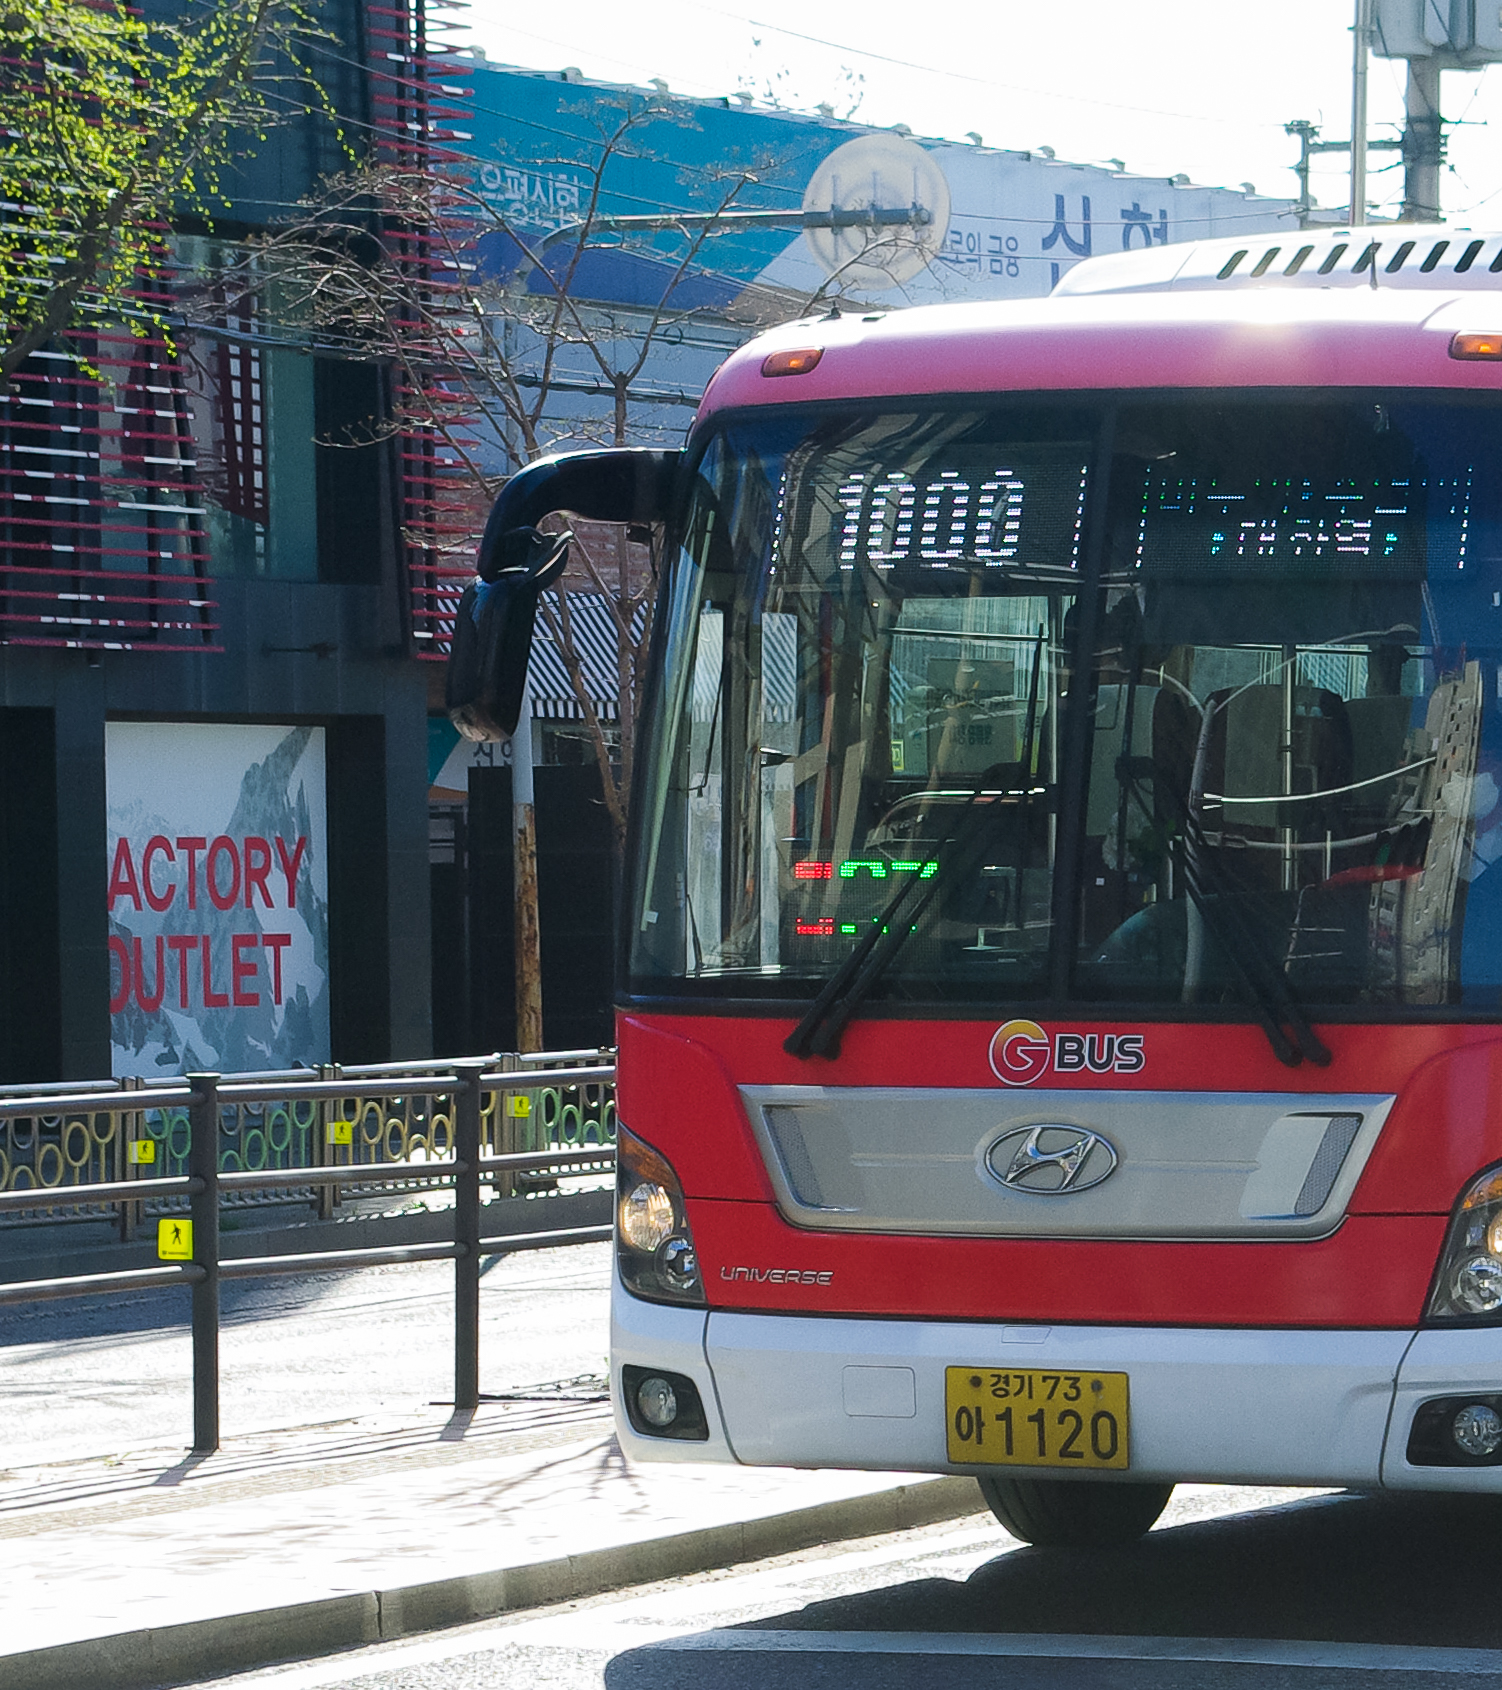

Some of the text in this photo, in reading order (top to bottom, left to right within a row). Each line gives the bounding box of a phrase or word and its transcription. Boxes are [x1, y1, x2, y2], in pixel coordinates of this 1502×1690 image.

[988, 234, 1019, 278] 금융
[838, 470, 1024, 569] 1000
[107, 834, 307, 913] ACTORY
[720, 1266, 834, 1285] UNIVERSE
